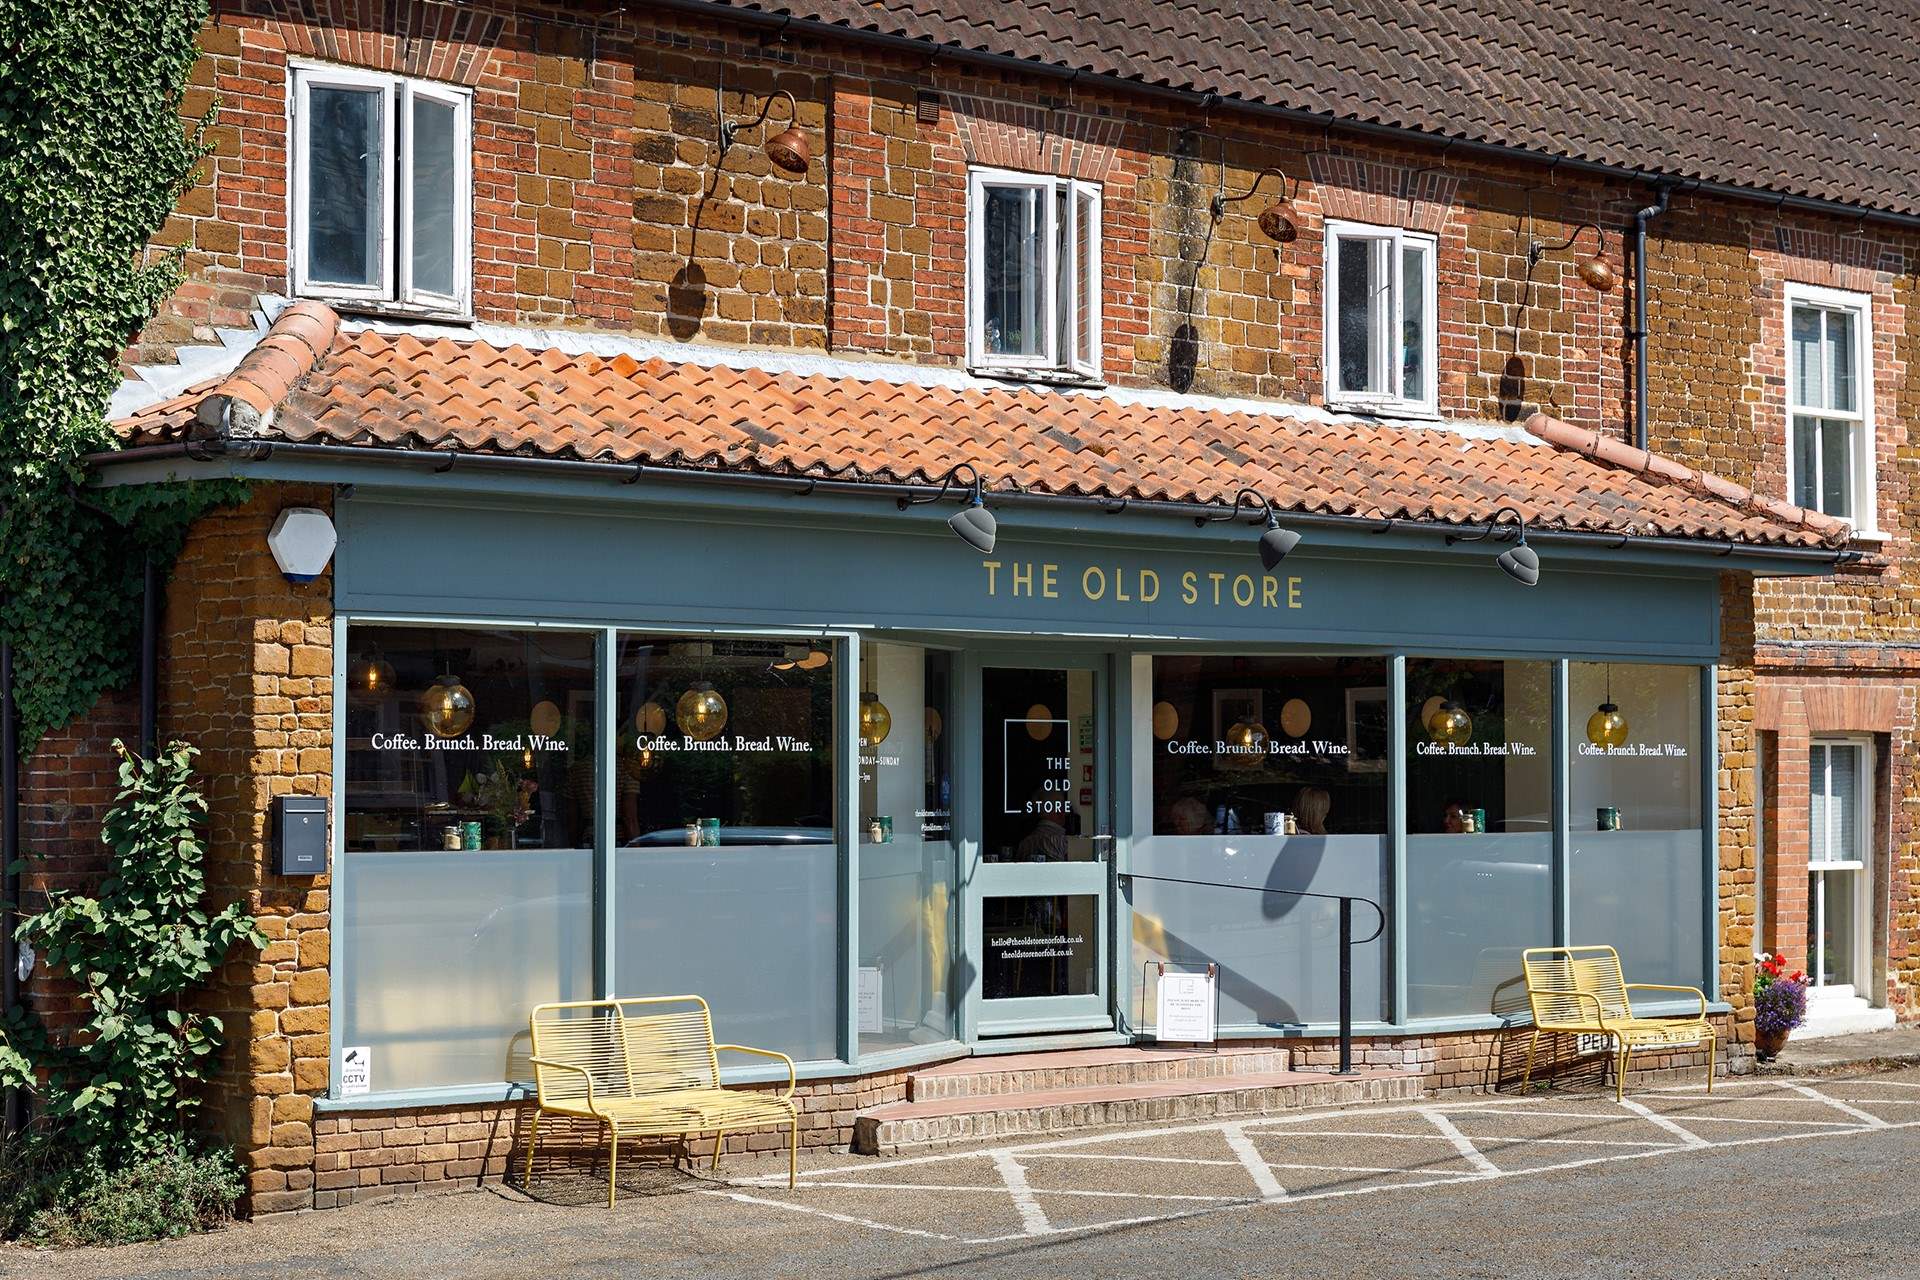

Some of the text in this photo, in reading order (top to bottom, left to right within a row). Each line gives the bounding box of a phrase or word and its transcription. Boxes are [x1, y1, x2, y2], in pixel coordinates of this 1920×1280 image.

[983, 560, 1303, 609] THE OLD STORE
[371, 733, 569, 751] Coffee. Brunch. Bread. Wine.
[636, 735, 813, 752] Coffee. Brunch. Bread. Wine.
[1167, 740, 1351, 756] Coffee. Brunch. Bread. Wine.
[1416, 741, 1537, 756] Coffee. Brunch. Bread. Wine.
[1578, 742, 1688, 756] Coffee. Brunch. Bread. Wine.
[1046, 757, 1071, 770] THE
[1043, 779, 1071, 792] OLD
[1026, 800, 1071, 813] STORE
[991, 934, 1084, 947] hello@theoldstorenorfolk.co.uk
[1001, 947, 1074, 959] theoldstorenorfolk.co.uk
[342, 1074, 366, 1084] CCTV
